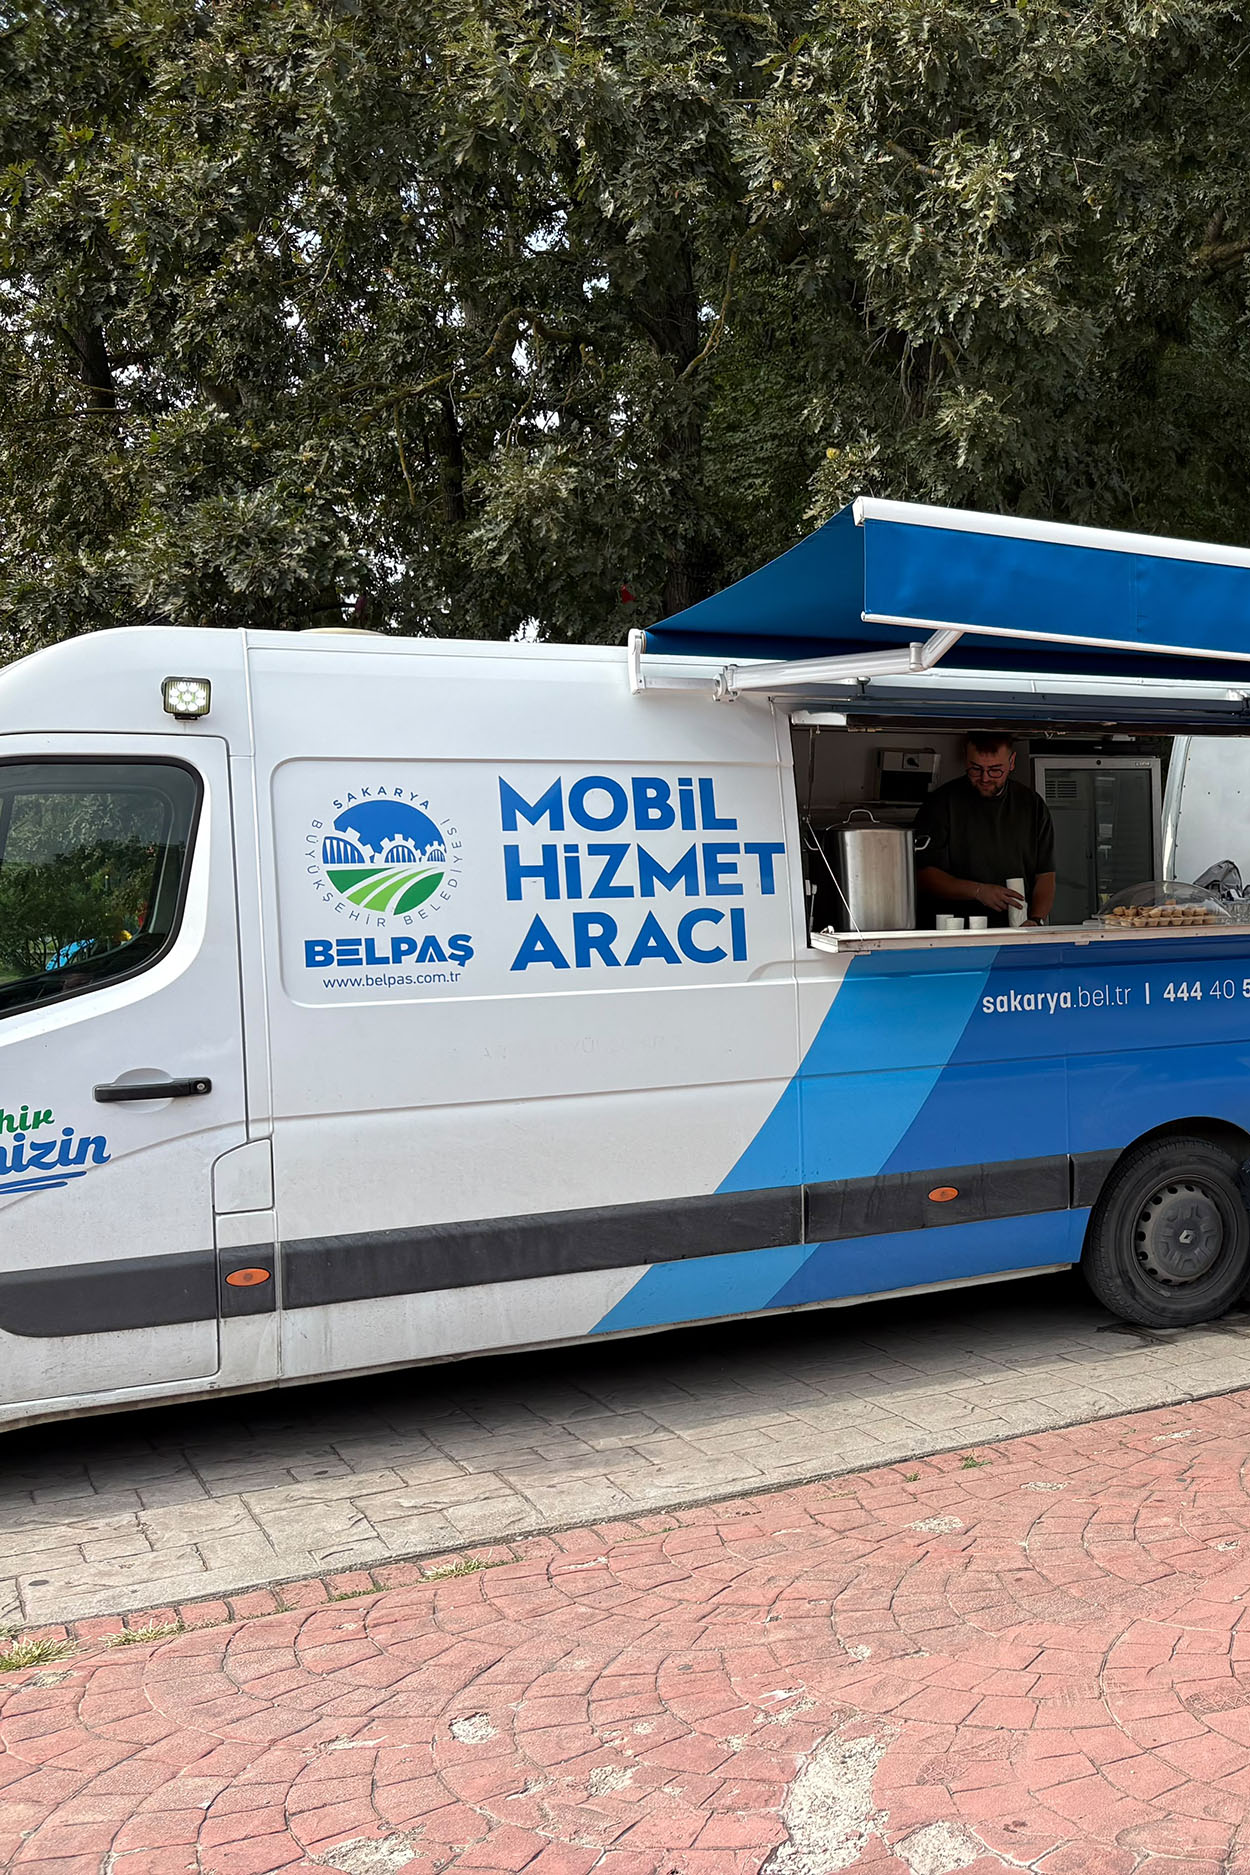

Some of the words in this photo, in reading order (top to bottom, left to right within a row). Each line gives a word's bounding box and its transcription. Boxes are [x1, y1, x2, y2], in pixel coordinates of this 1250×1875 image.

[333, 785, 430, 810] SAKARYA
[304, 819, 386, 927] BÜYÜKŞEHİR
[304, 933, 475, 968] BELPAŞ
[509, 908, 748, 972] ARACI
[323, 971, 461, 989] www.belpas.com.tr
[982, 985, 1131, 1015] sakarya.bel.tr
[1163, 981, 1202, 1003] 444
[1209, 978, 1235, 1000] 40
